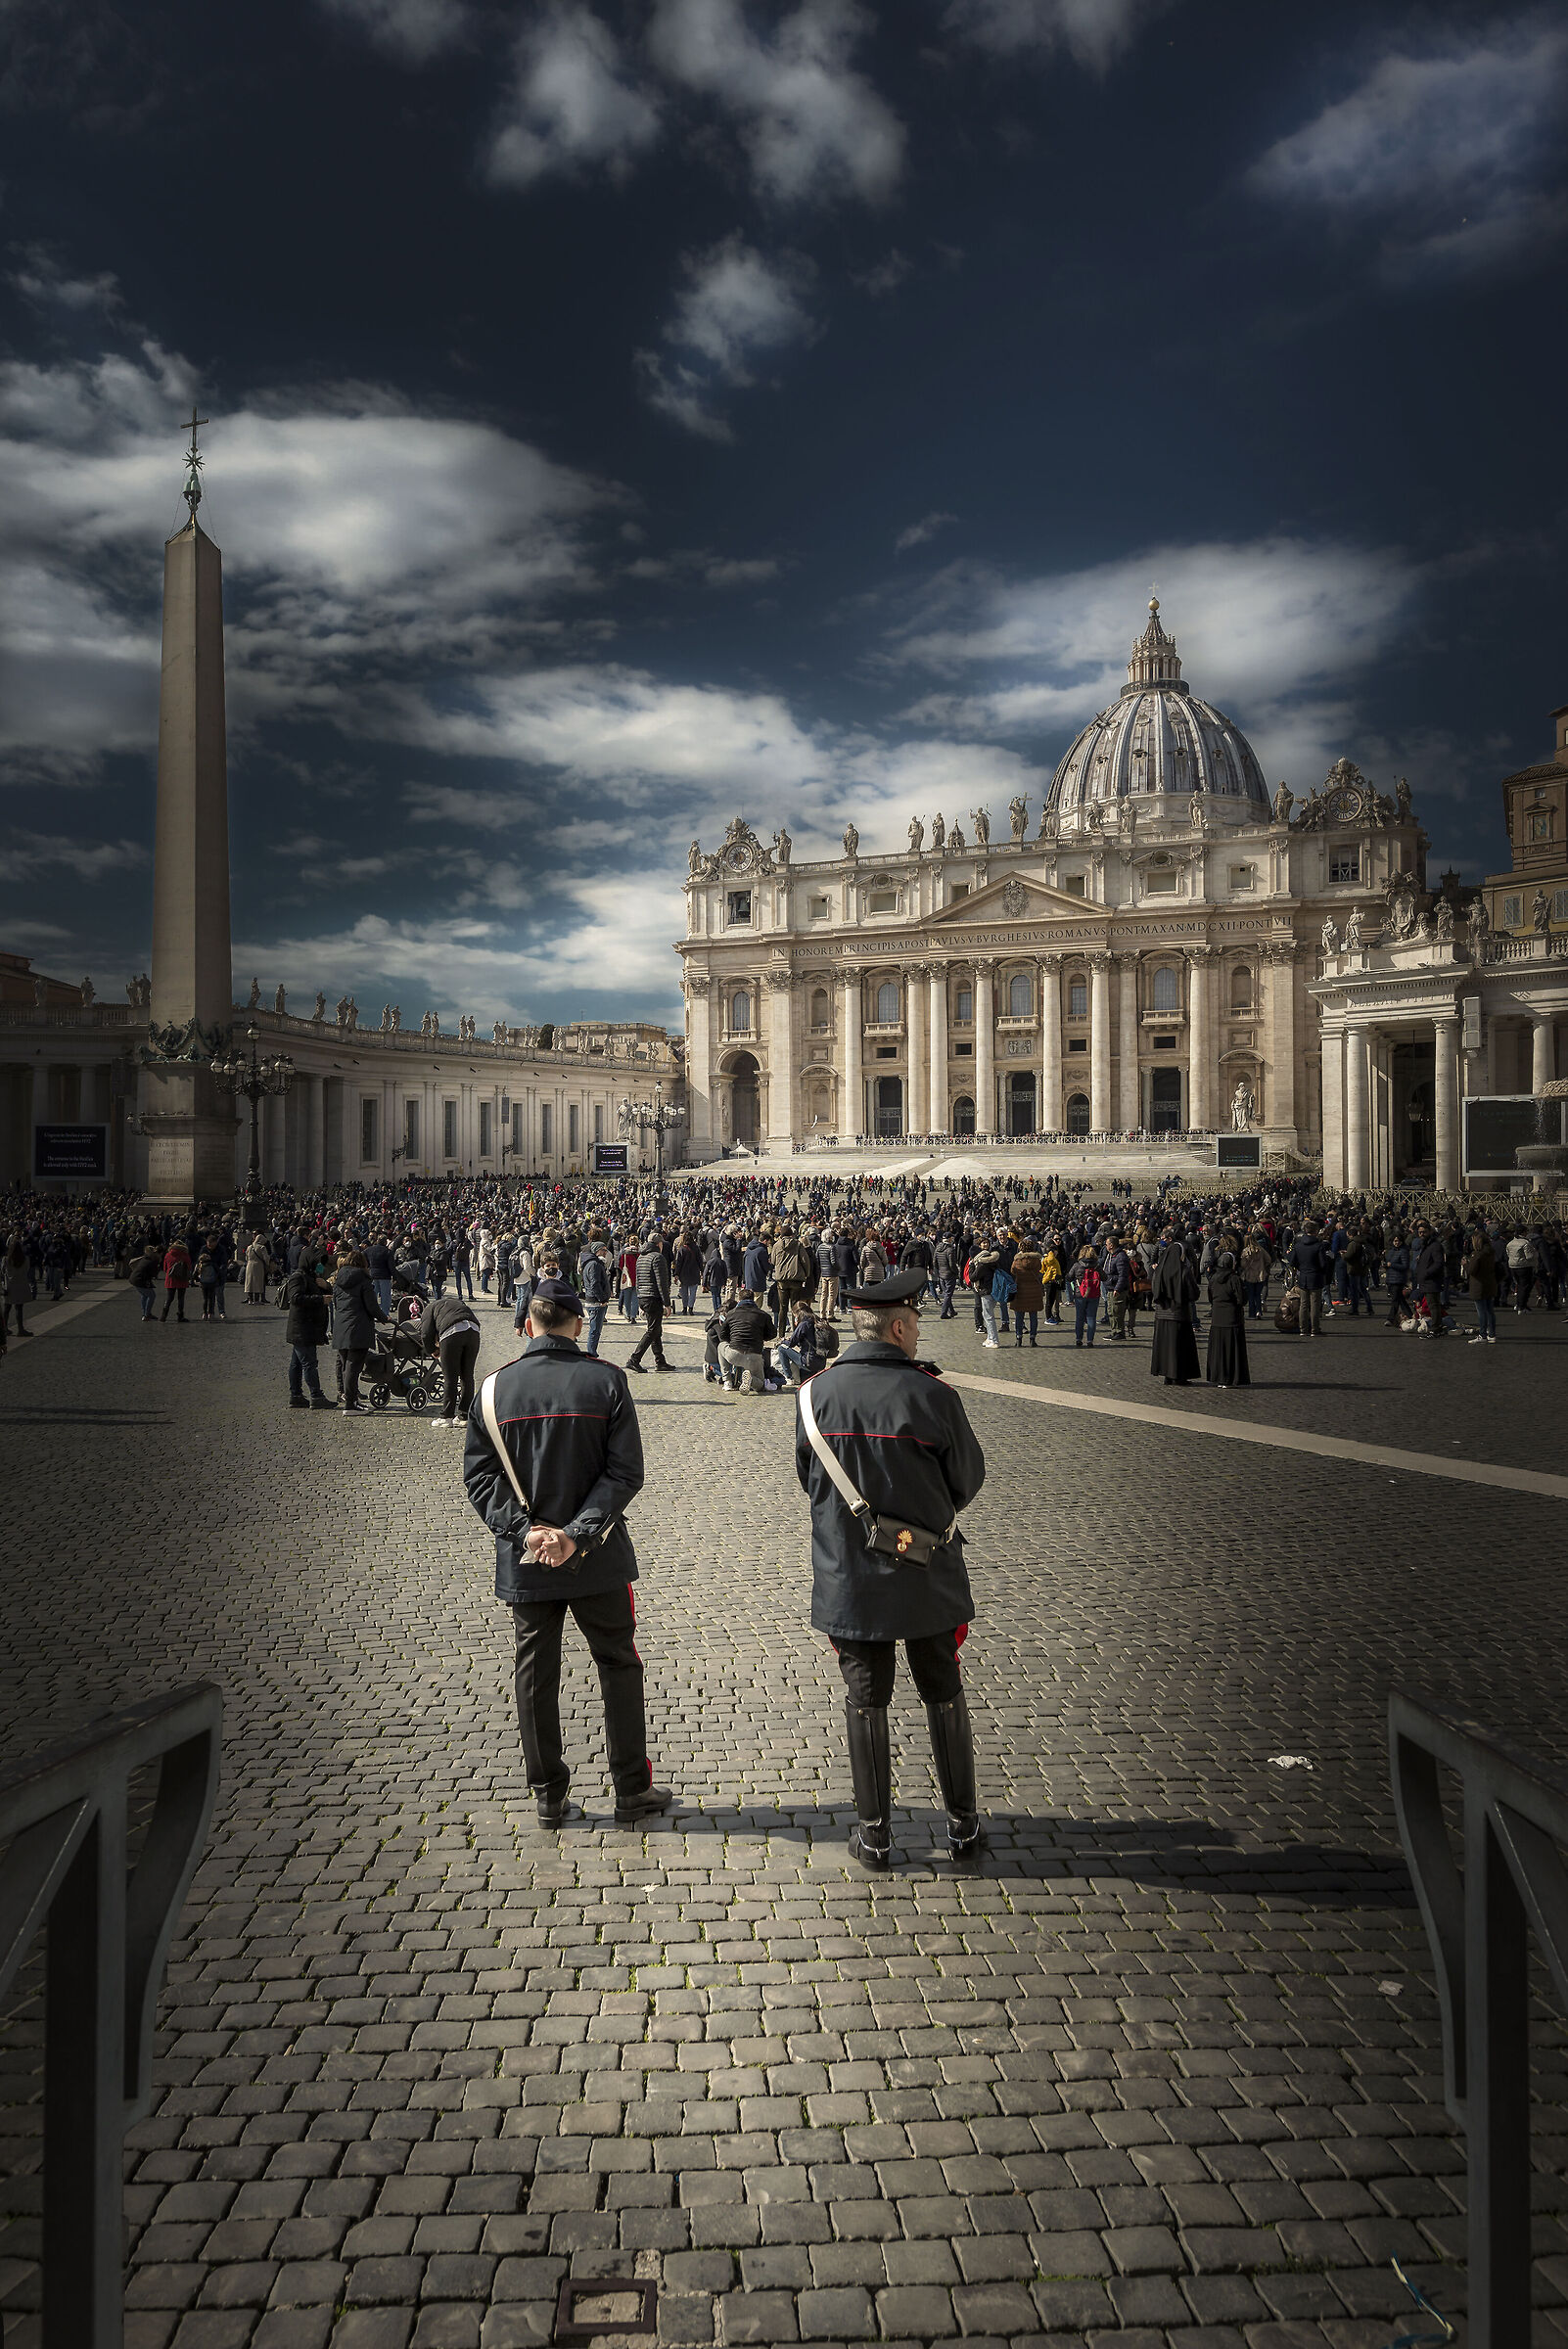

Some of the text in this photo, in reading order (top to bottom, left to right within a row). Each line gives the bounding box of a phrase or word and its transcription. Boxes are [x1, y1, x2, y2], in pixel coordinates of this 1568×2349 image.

[773, 947, 785, 957] IN
[791, 945, 843, 957] HONOREM
[1048, 927, 1106, 940] ROMANVS
